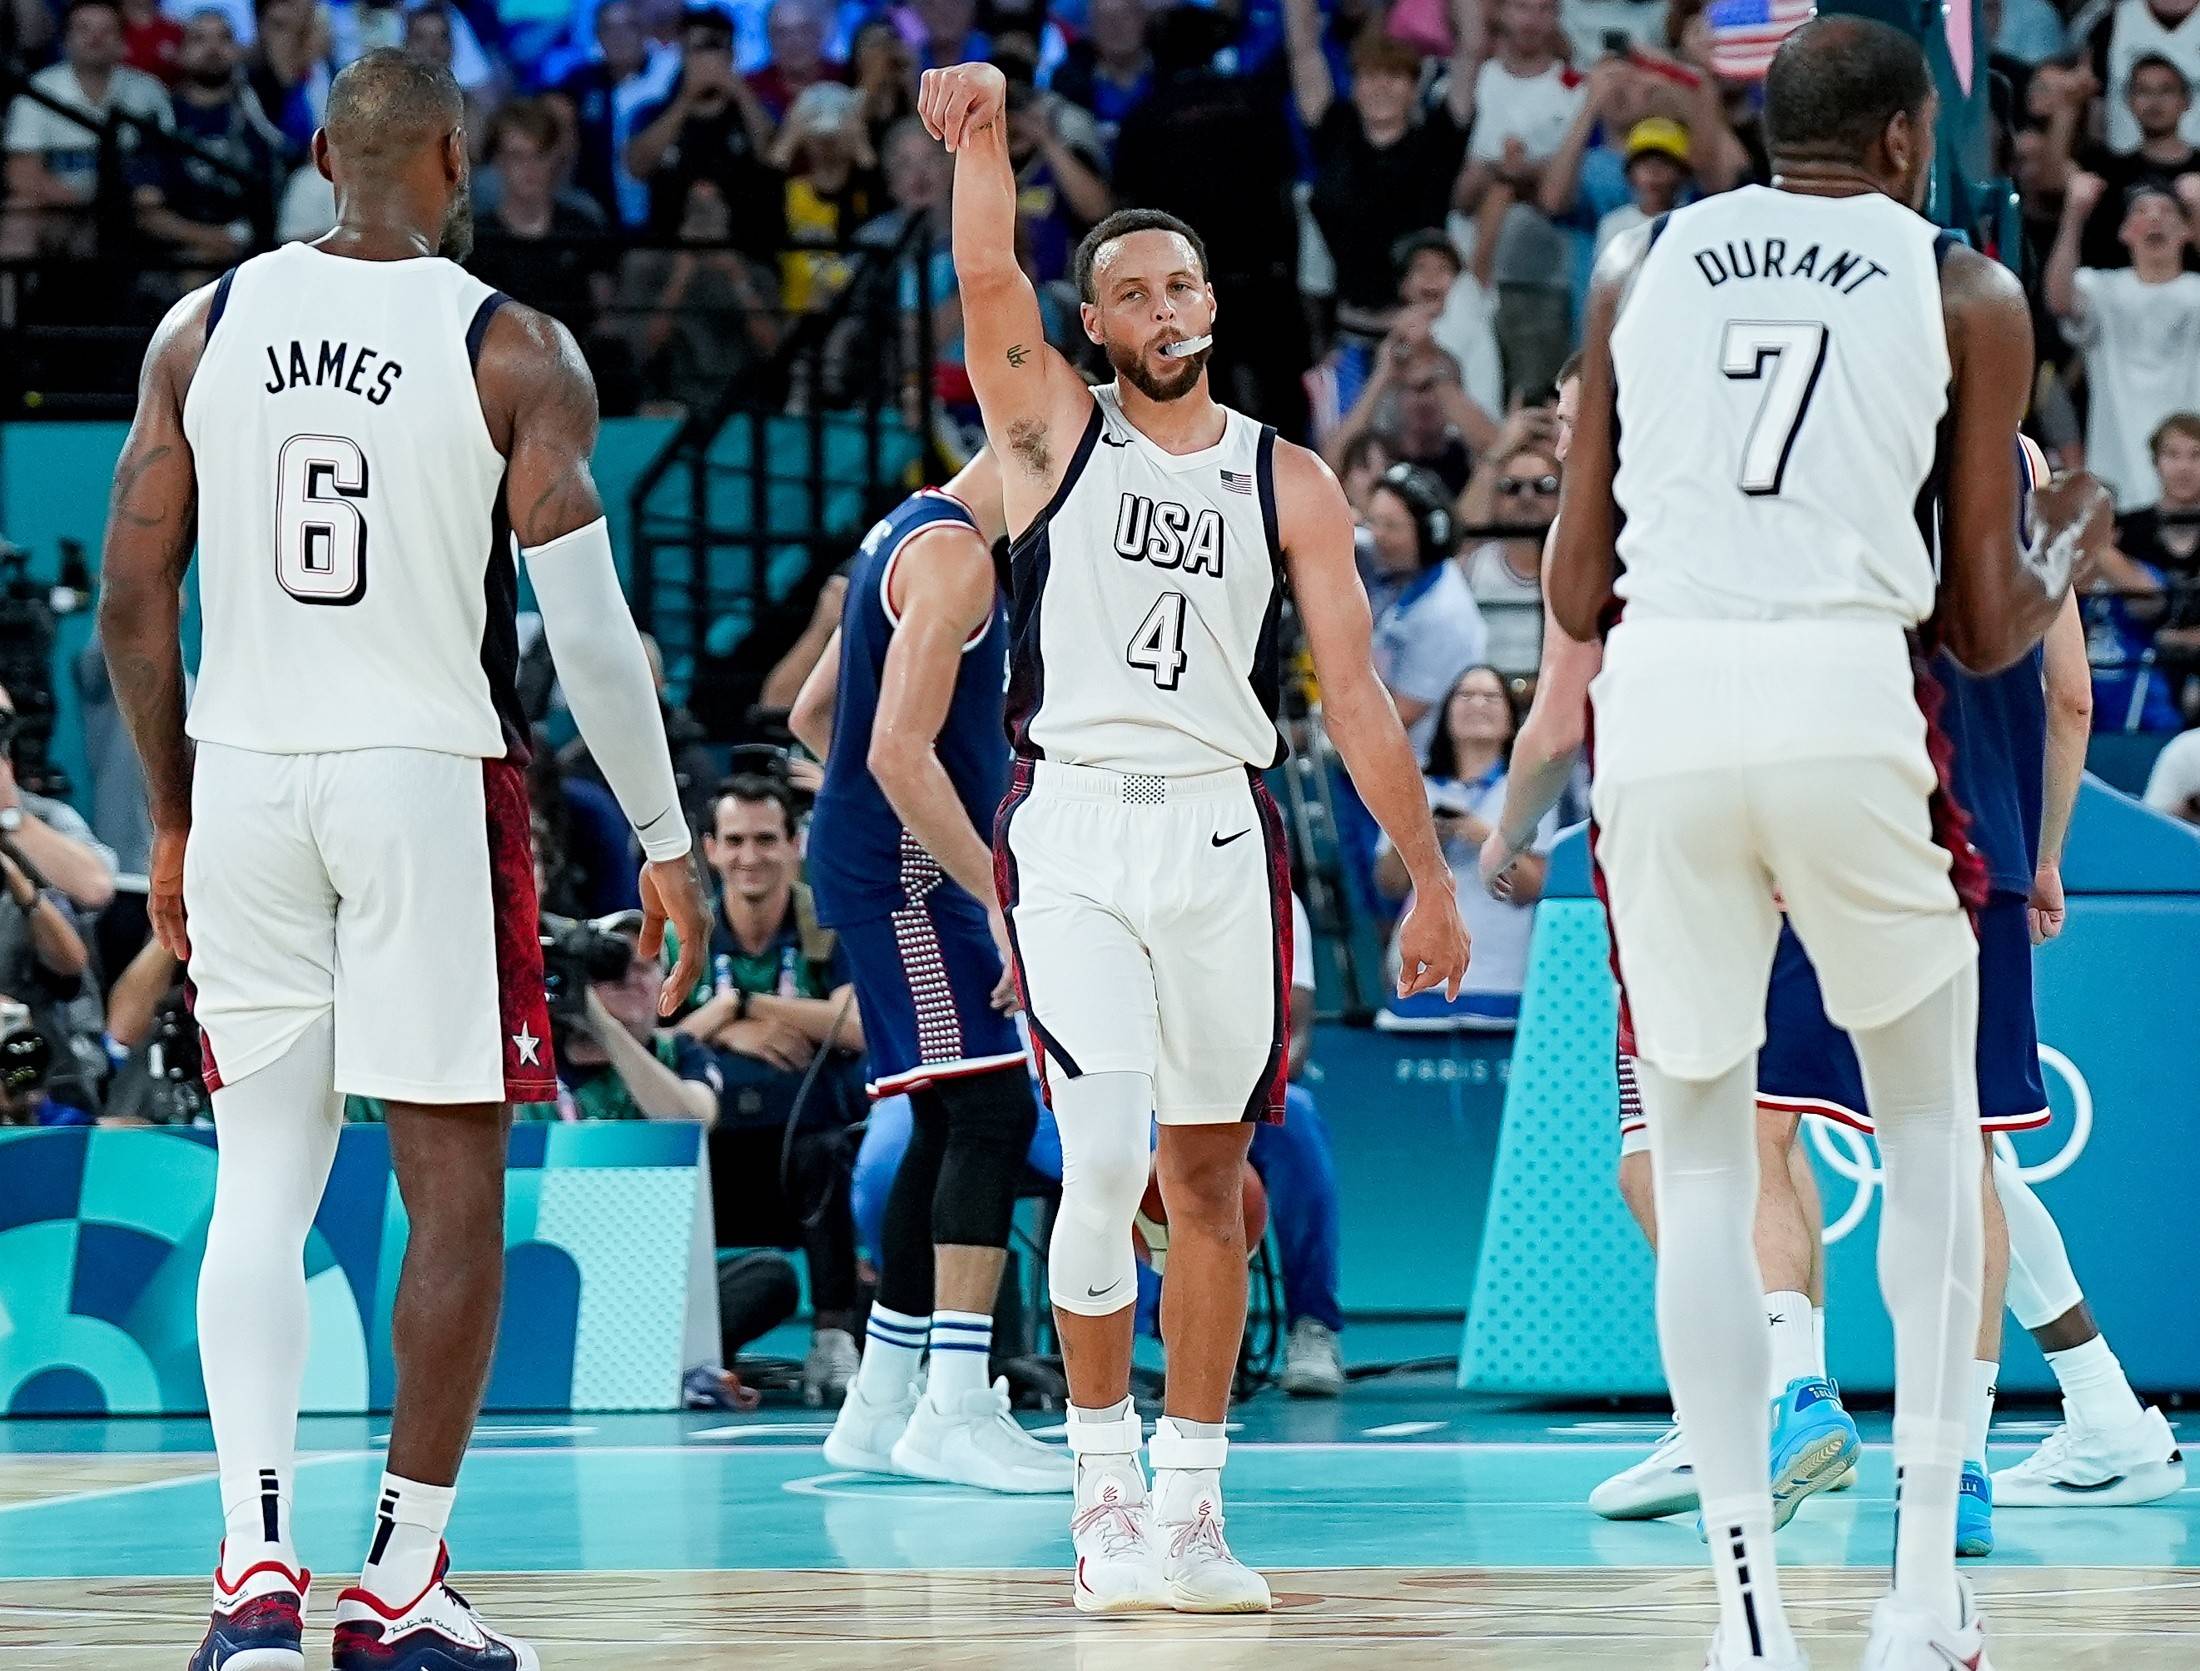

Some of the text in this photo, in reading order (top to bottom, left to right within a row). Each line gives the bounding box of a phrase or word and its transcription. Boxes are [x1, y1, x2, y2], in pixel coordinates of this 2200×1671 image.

[1694, 238, 1889, 295] DURANT
[265, 339, 402, 405] JAMES
[1719, 318, 1829, 496] 7
[275, 433, 369, 607] 6
[1114, 492, 1225, 578] USA
[1127, 591, 1188, 691] 4
